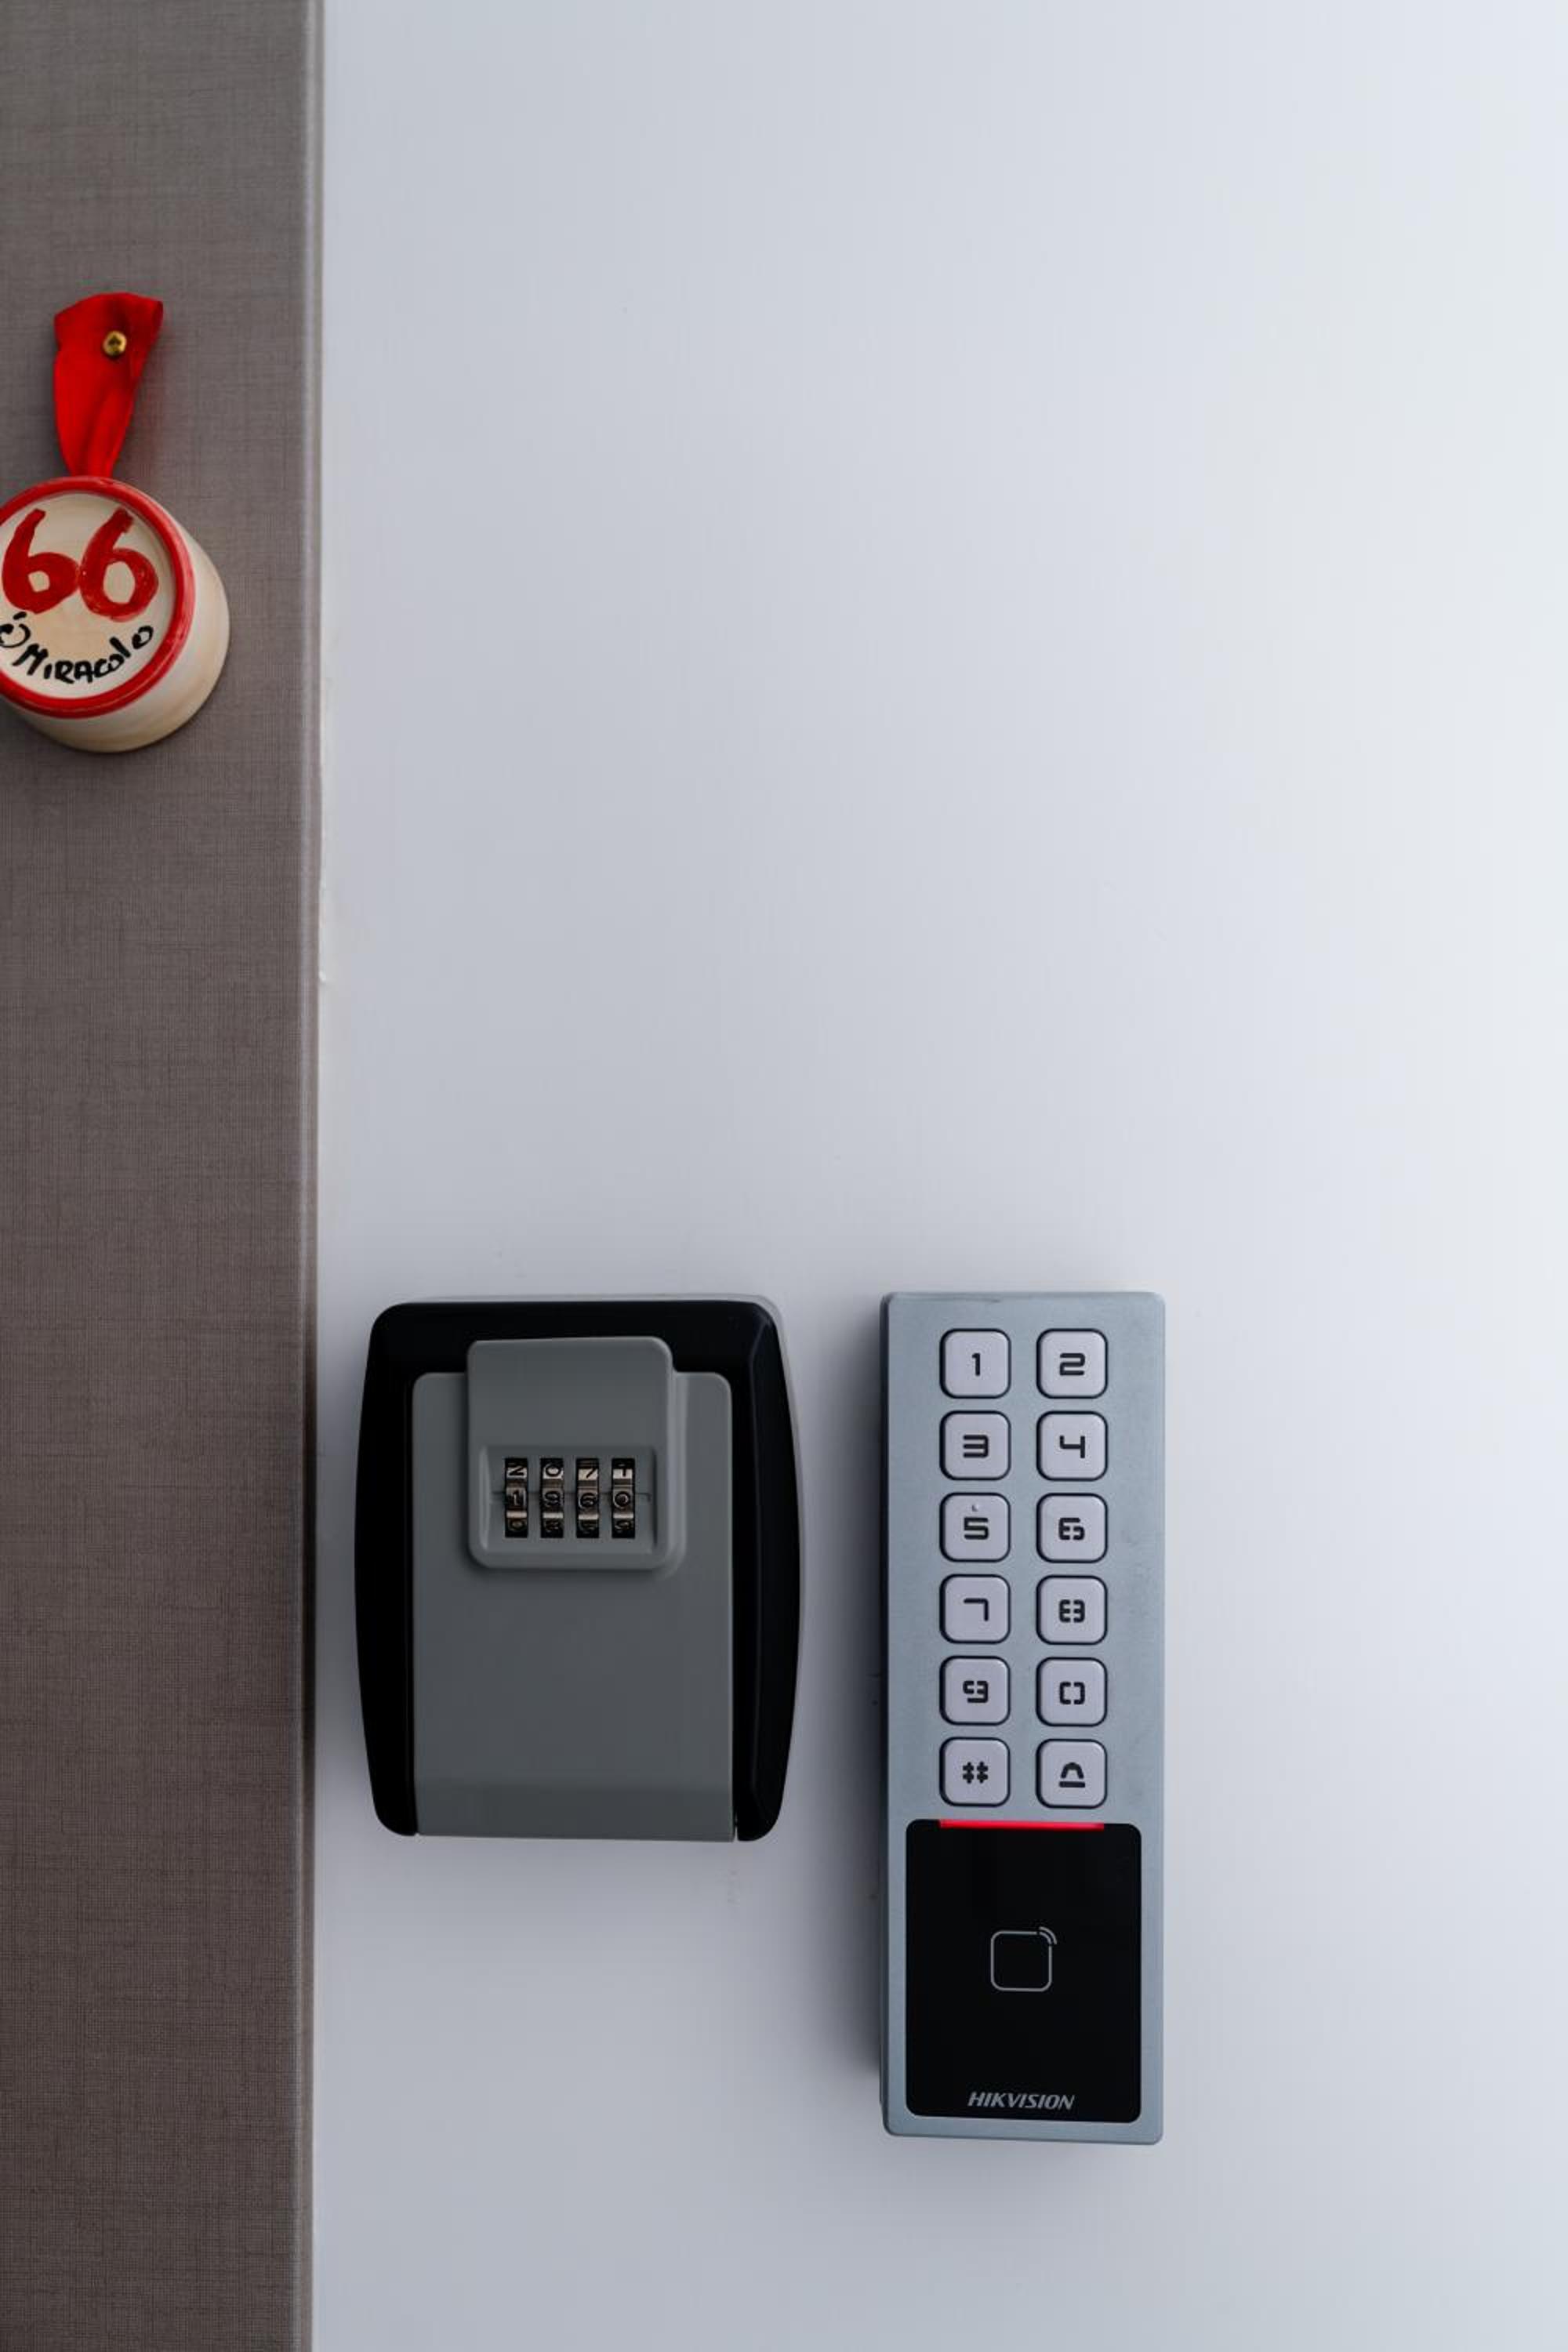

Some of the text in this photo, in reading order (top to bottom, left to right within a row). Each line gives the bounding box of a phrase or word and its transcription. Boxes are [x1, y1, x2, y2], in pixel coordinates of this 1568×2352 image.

[2, 506, 159, 622] 66
[971, 1352, 1086, 1377] 1 2
[963, 1434, 1086, 1459] 3 4
[964, 1517, 1086, 1541] 5 6
[964, 1598, 1086, 1623] 7 8
[963, 1680, 1086, 1705] 9 0
[967, 2091, 1075, 2110] HIKVISION
